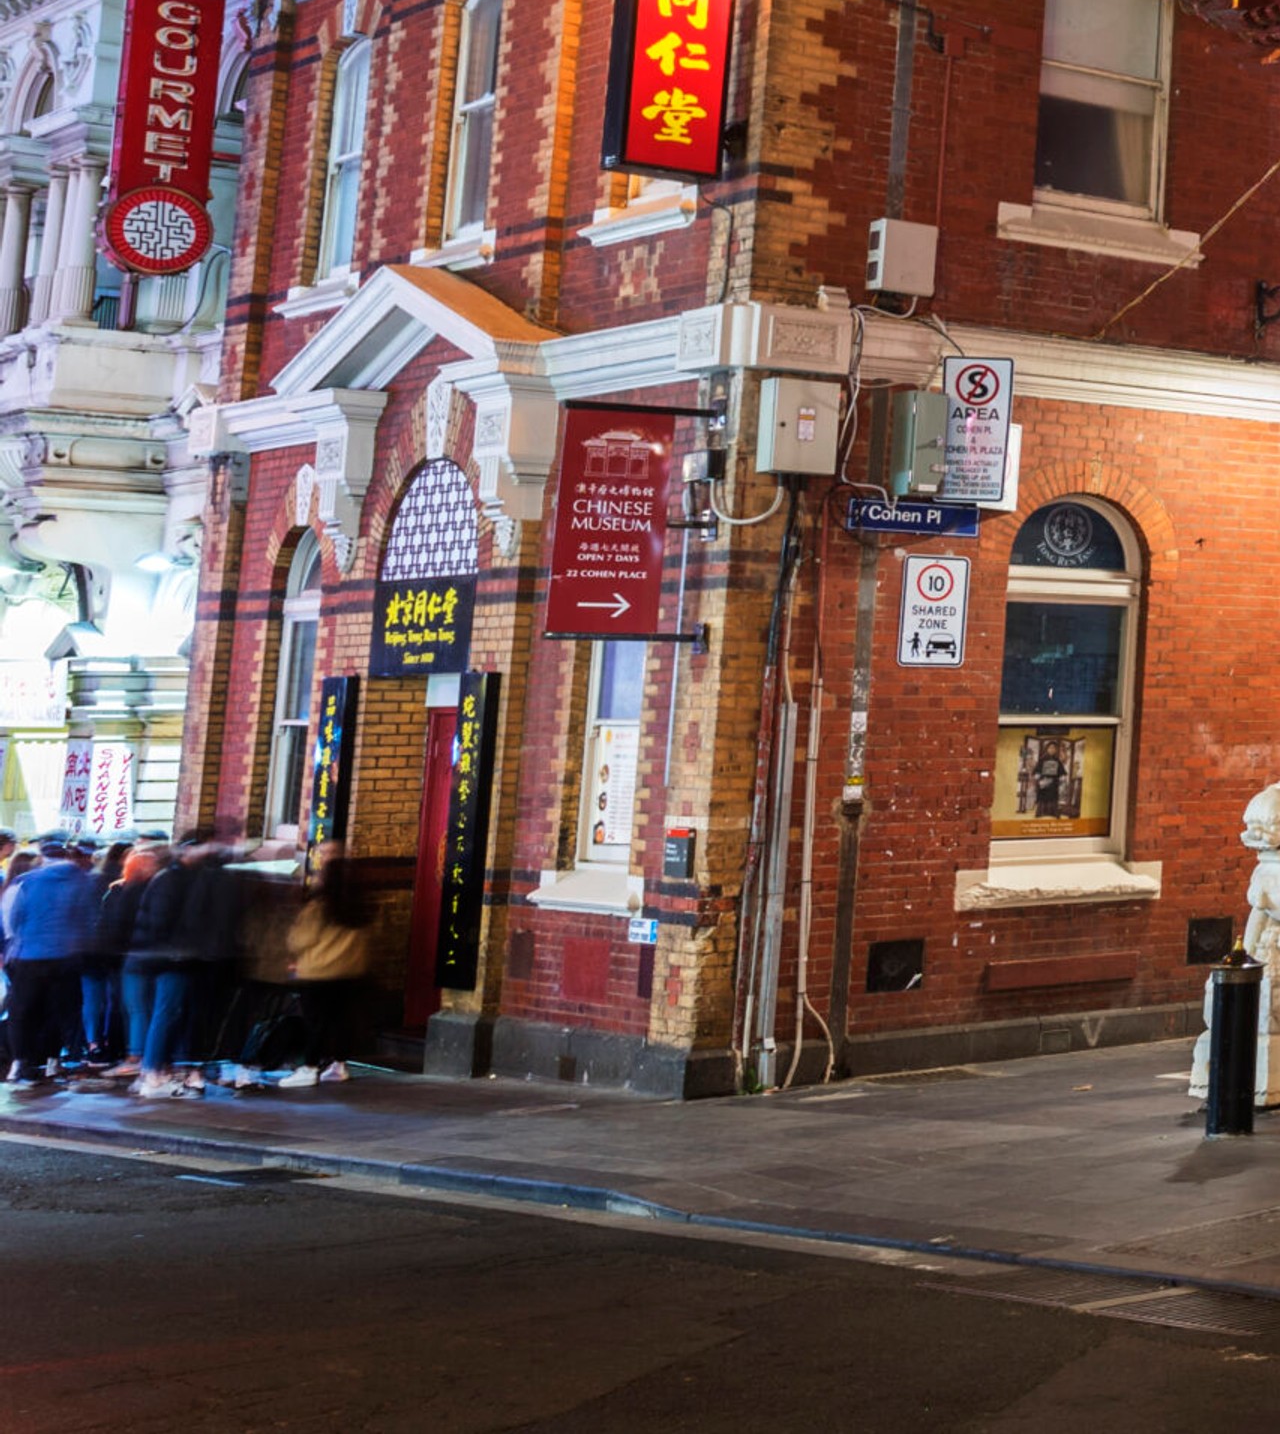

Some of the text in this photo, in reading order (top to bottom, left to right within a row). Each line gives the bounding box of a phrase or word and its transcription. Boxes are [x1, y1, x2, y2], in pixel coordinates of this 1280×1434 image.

[144, 0, 202, 183] GOURMET
[951, 406, 1000, 421] AREA
[572, 498, 654, 516] CHINESE
[868, 505, 942, 524] Cohen Pl
[571, 516, 652, 532] MUSEUM
[577, 553, 640, 563] OPEN 7 DAYS
[566, 569, 648, 579] 22 COHEN PLACE
[928, 575, 945, 592] 10
[911, 605, 957, 616] SHARED
[918, 618, 948, 629] ZONE
[93, 748, 113, 834] SHANGHAI
[114, 752, 134, 830] VILLAGE
